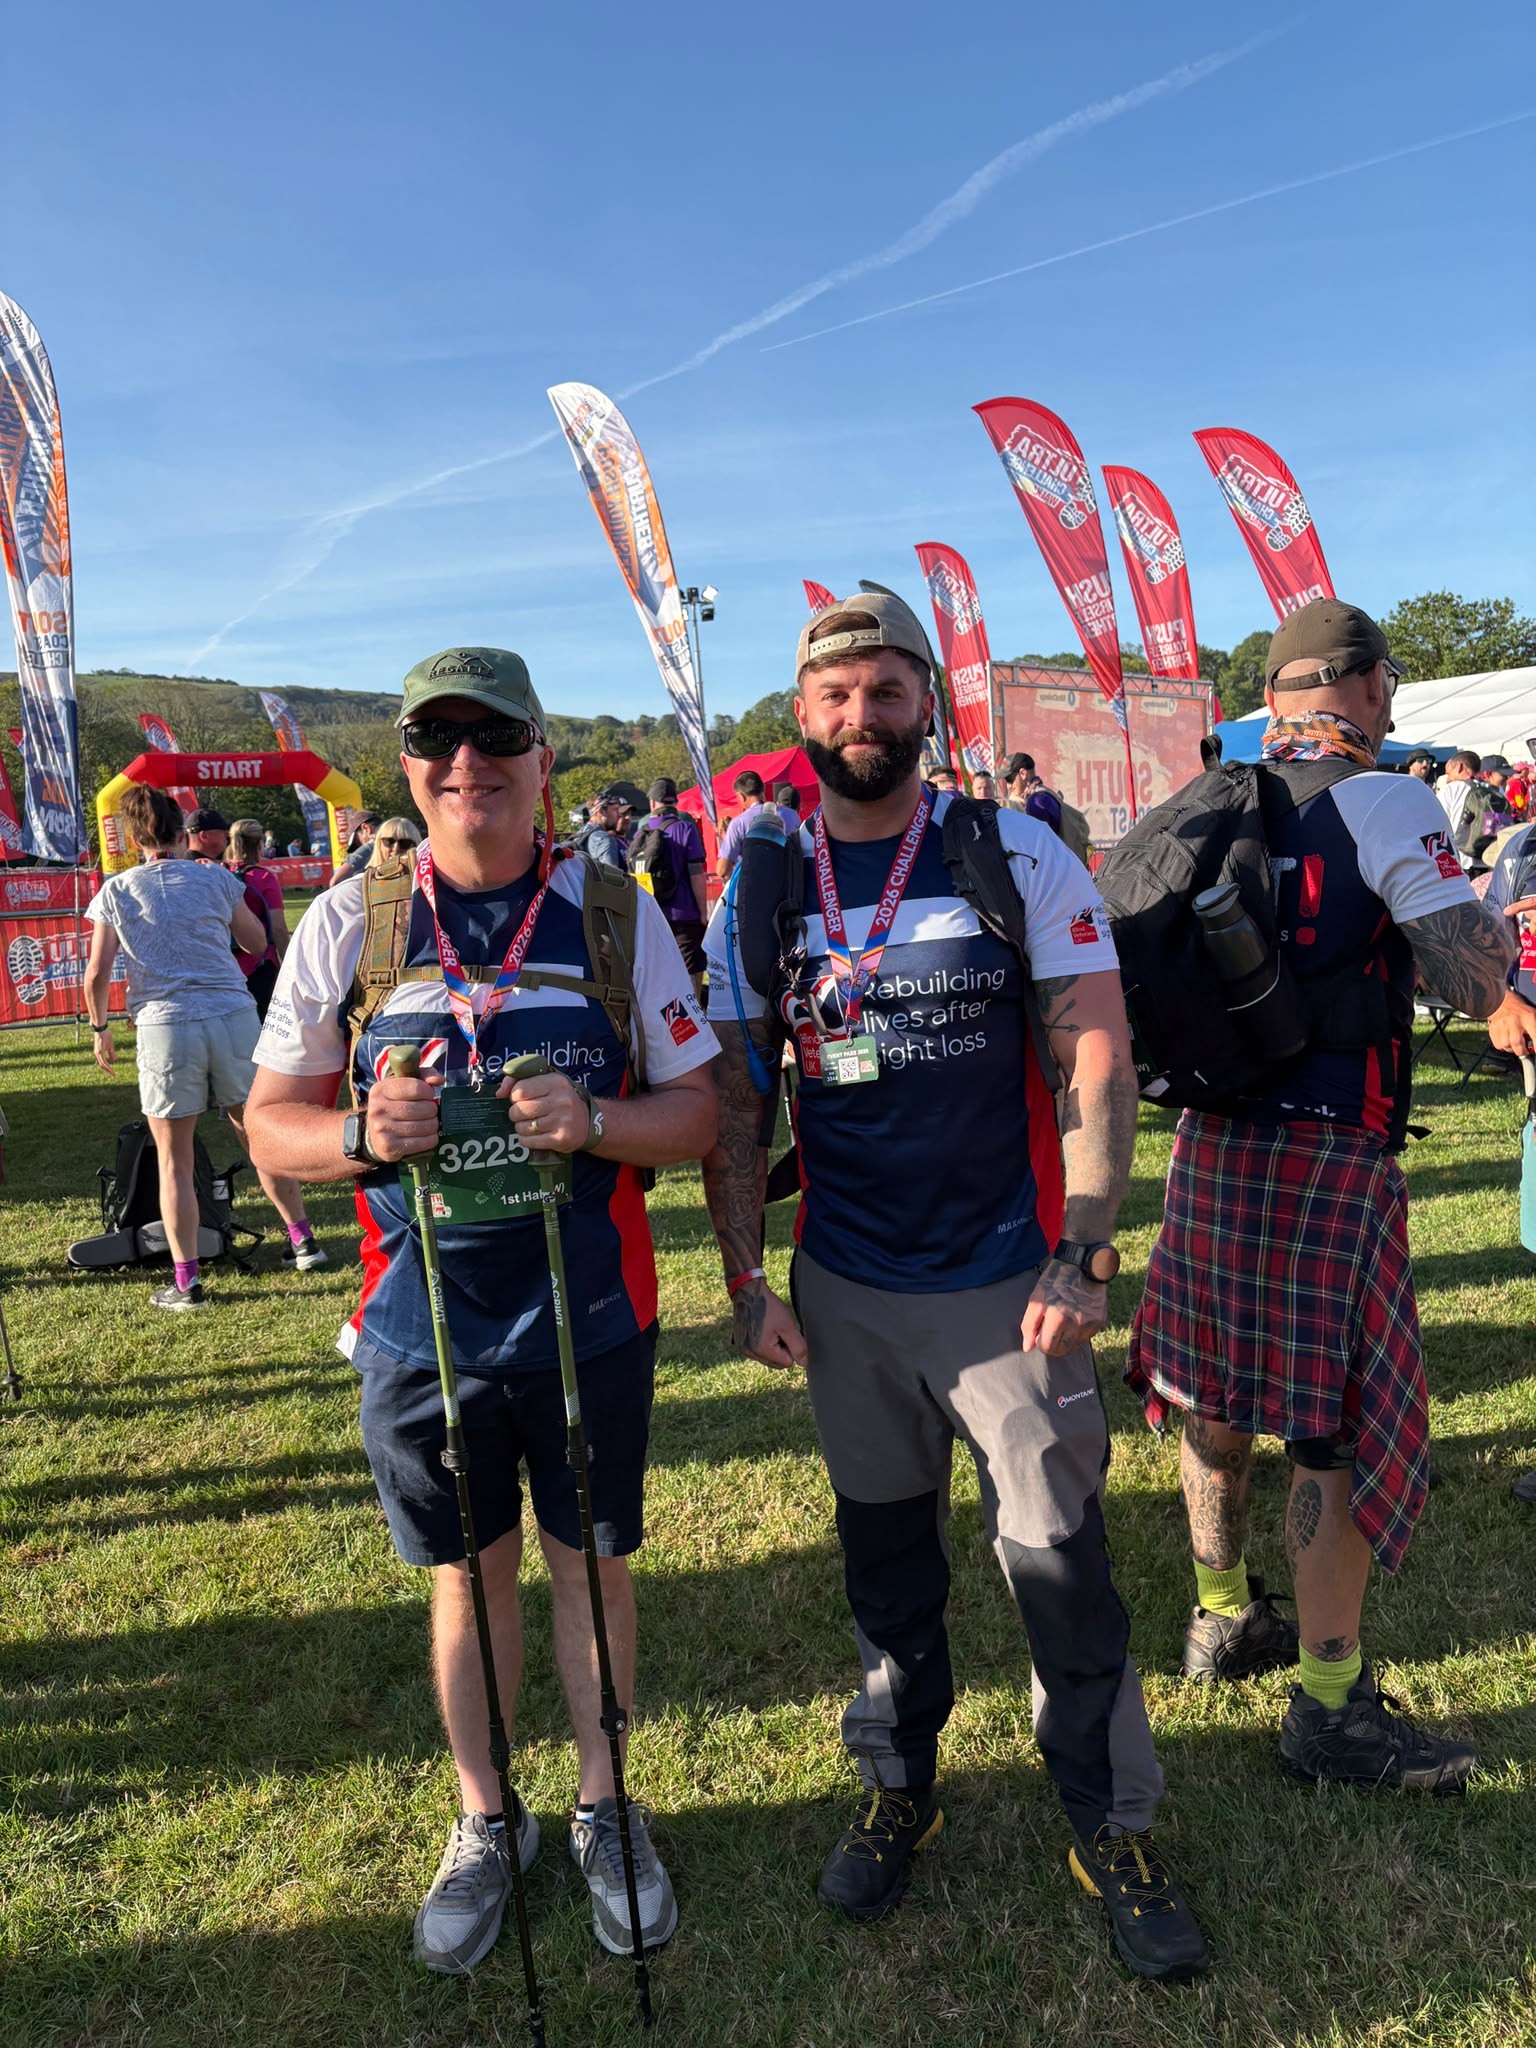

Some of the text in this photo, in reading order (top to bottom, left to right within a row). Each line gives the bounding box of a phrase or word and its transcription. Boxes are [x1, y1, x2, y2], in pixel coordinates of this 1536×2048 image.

[198, 760, 262, 779] START
[104, 818, 119, 853] ULTRA
[337, 809, 349, 843] ULTRA
[875, 801, 929, 927] 2026 CHALLENGER
[817, 849, 842, 935] CHALLENGER
[509, 927, 532, 967] 2026
[276, 1024, 291, 1039] loss
[863, 999, 991, 1034] lives after
[467, 1041, 605, 1074] Rebilding
[803, 1047, 821, 1059] Vete
[942, 1031, 987, 1057] loss
[806, 1061, 817, 1072] UK
[1135, 1063, 1150, 1073] W)
[438, 1133, 530, 1173] 3225
[501, 1194, 520, 1205] 1st
[523, 1189, 544, 1202] Hal
[433, 1286, 446, 1325] CRIVIT
[553, 1290, 564, 1327] CRIVIT
[1065, 1388, 1095, 1403] MONTANE
